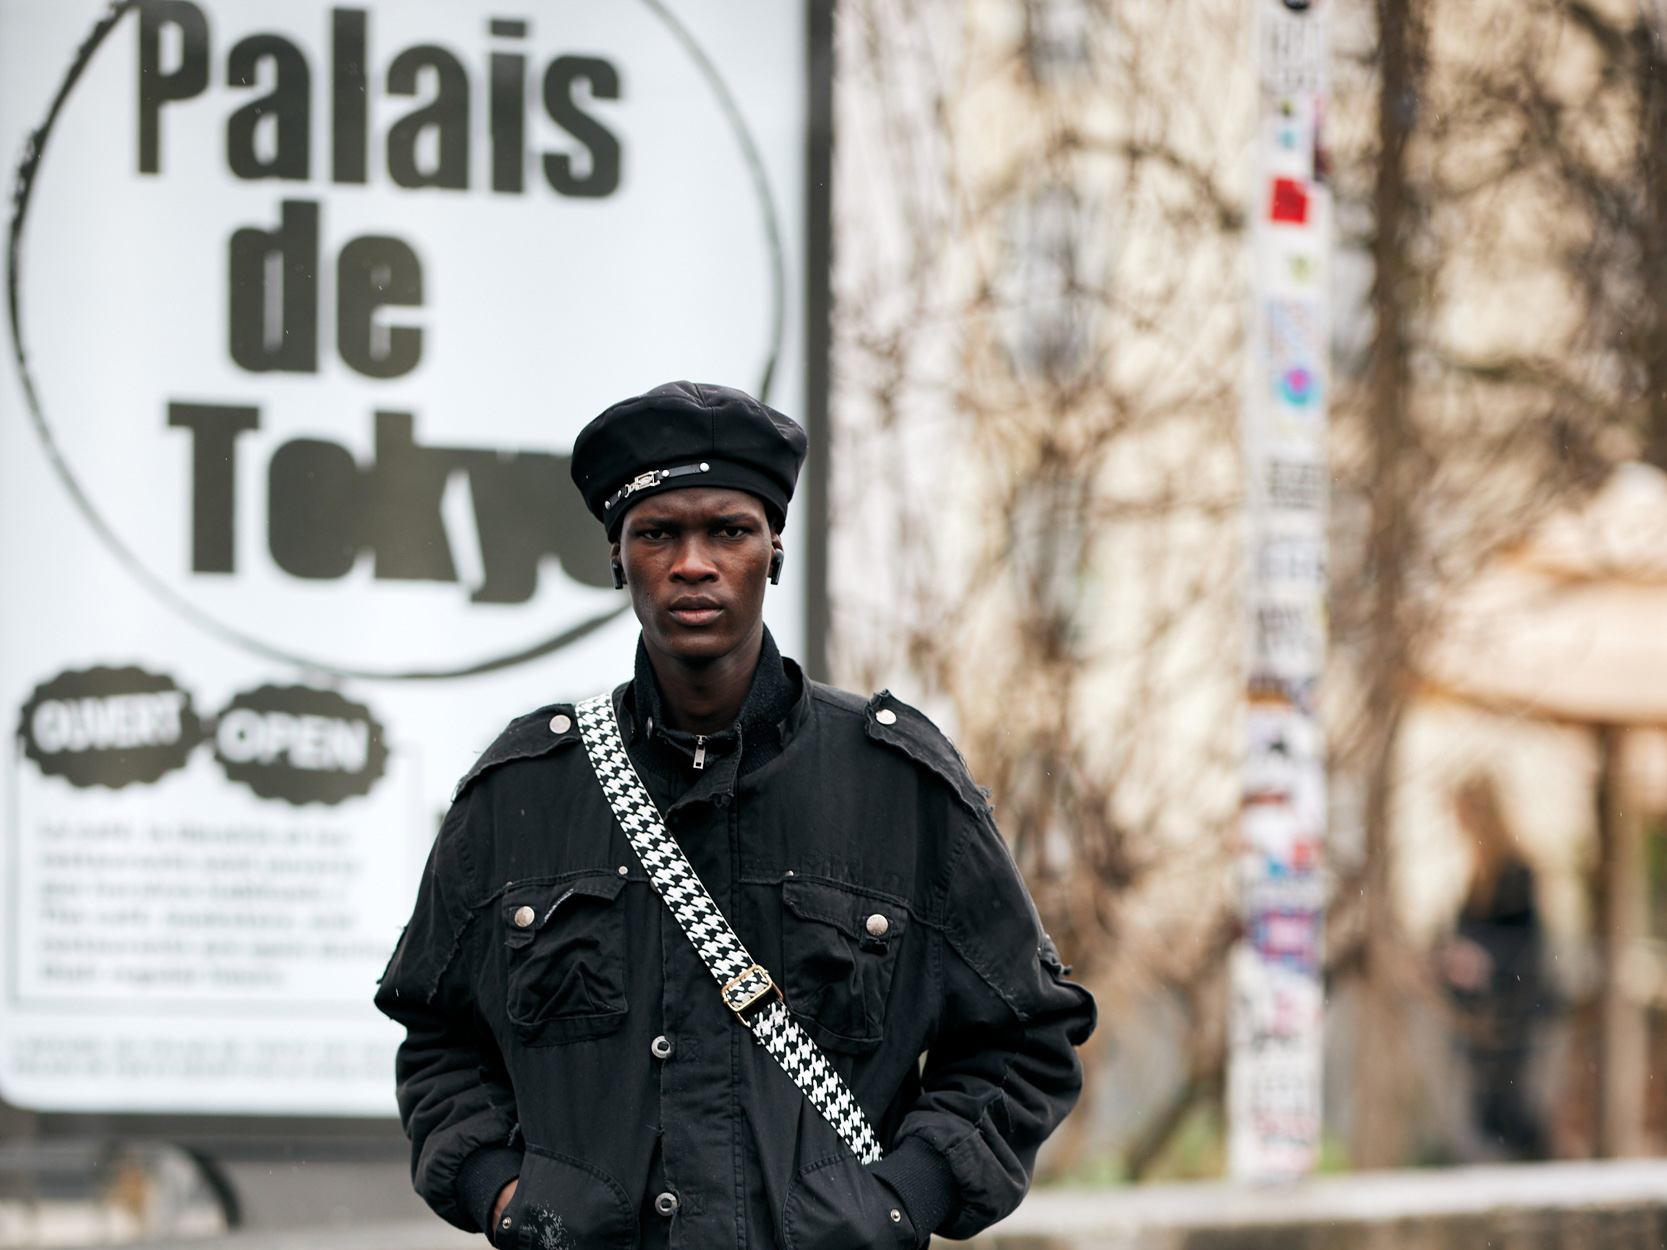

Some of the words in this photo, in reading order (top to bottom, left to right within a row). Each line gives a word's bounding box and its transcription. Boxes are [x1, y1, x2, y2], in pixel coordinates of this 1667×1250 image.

[137, 0, 621, 198] Palais
[228, 199, 424, 379] de
[33, 693, 184, 752] OUVERT
[215, 708, 369, 773] OPEN
